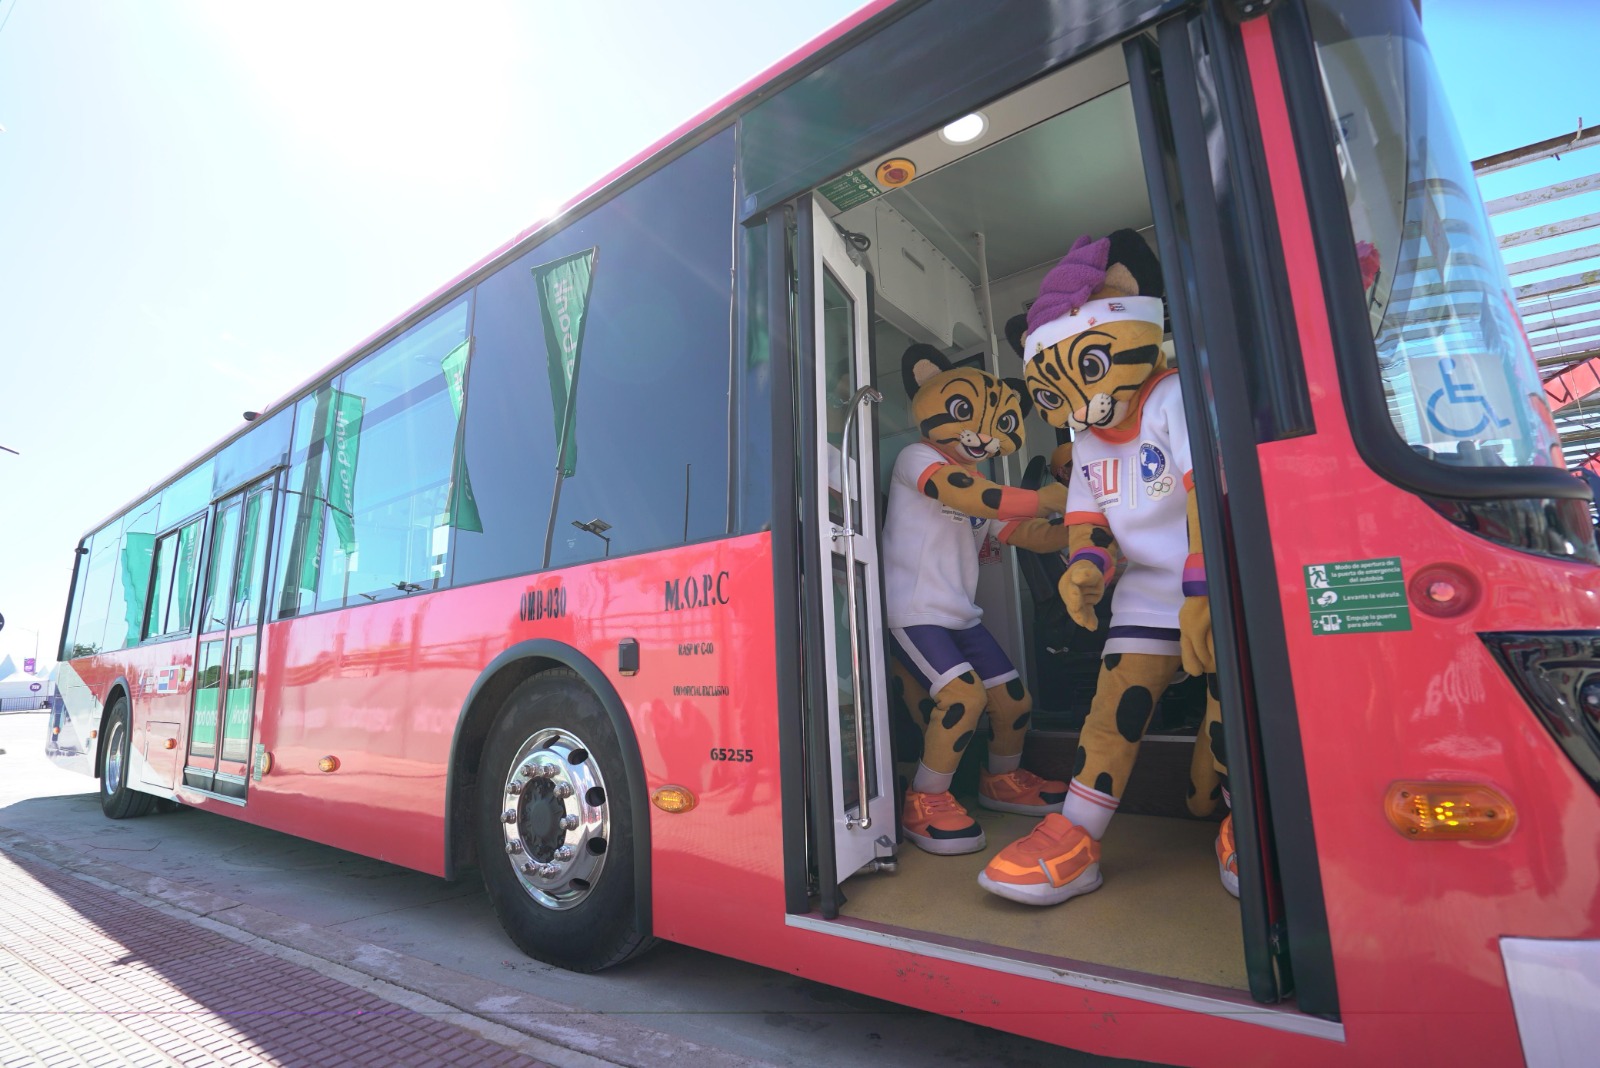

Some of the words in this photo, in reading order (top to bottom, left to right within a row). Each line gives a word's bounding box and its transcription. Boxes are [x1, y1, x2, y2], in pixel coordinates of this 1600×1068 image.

[1334, 563, 1352, 571] Modo
[1361, 561, 1386, 570] apertura
[1338, 570, 1356, 578] puerta
[1366, 567, 1401, 576] emergencia
[664, 571, 730, 612] M.O.P.C
[1310, 596, 1315, 605] 1
[1346, 614, 1369, 622] Empuje
[1312, 620, 1319, 629] 2
[709, 747, 754, 763] 65255
